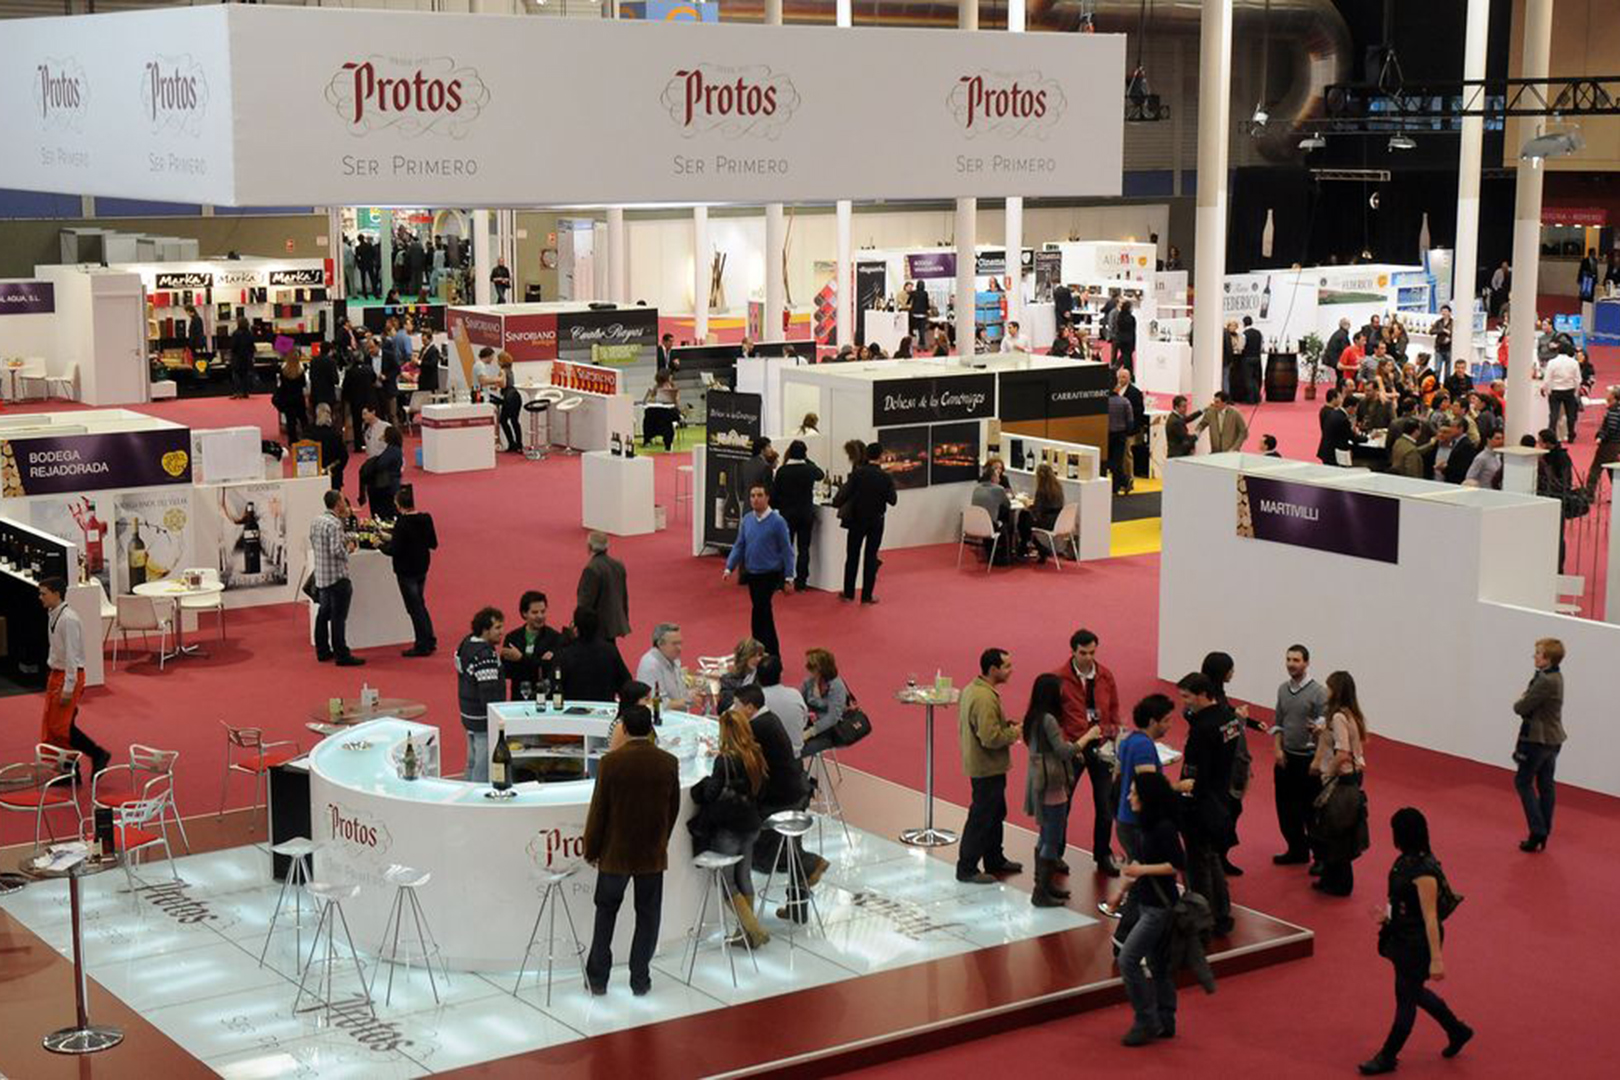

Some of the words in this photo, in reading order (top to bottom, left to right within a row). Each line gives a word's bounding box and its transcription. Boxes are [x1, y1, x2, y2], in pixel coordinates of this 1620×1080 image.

[37, 64, 80, 119] Protos
[146, 61, 197, 121] Protos
[341, 62, 462, 124] Protos
[675, 70, 777, 127] Protos
[959, 75, 1047, 128] Protos
[342, 155, 379, 176] SER
[393, 155, 478, 176] PRIMERO
[673, 155, 705, 175] SER
[716, 155, 789, 175] PRIMERO
[956, 154, 984, 173] SER
[993, 154, 1056, 173] PRIMERO
[505, 330, 556, 342] SINFORIANO
[29, 449, 81, 464] BODEGA
[30, 461, 110, 478] REJADORADA
[1260, 499, 1320, 521] MARTIVILLI
[328, 803, 378, 848] Protos
[539, 828, 585, 867] Pro
